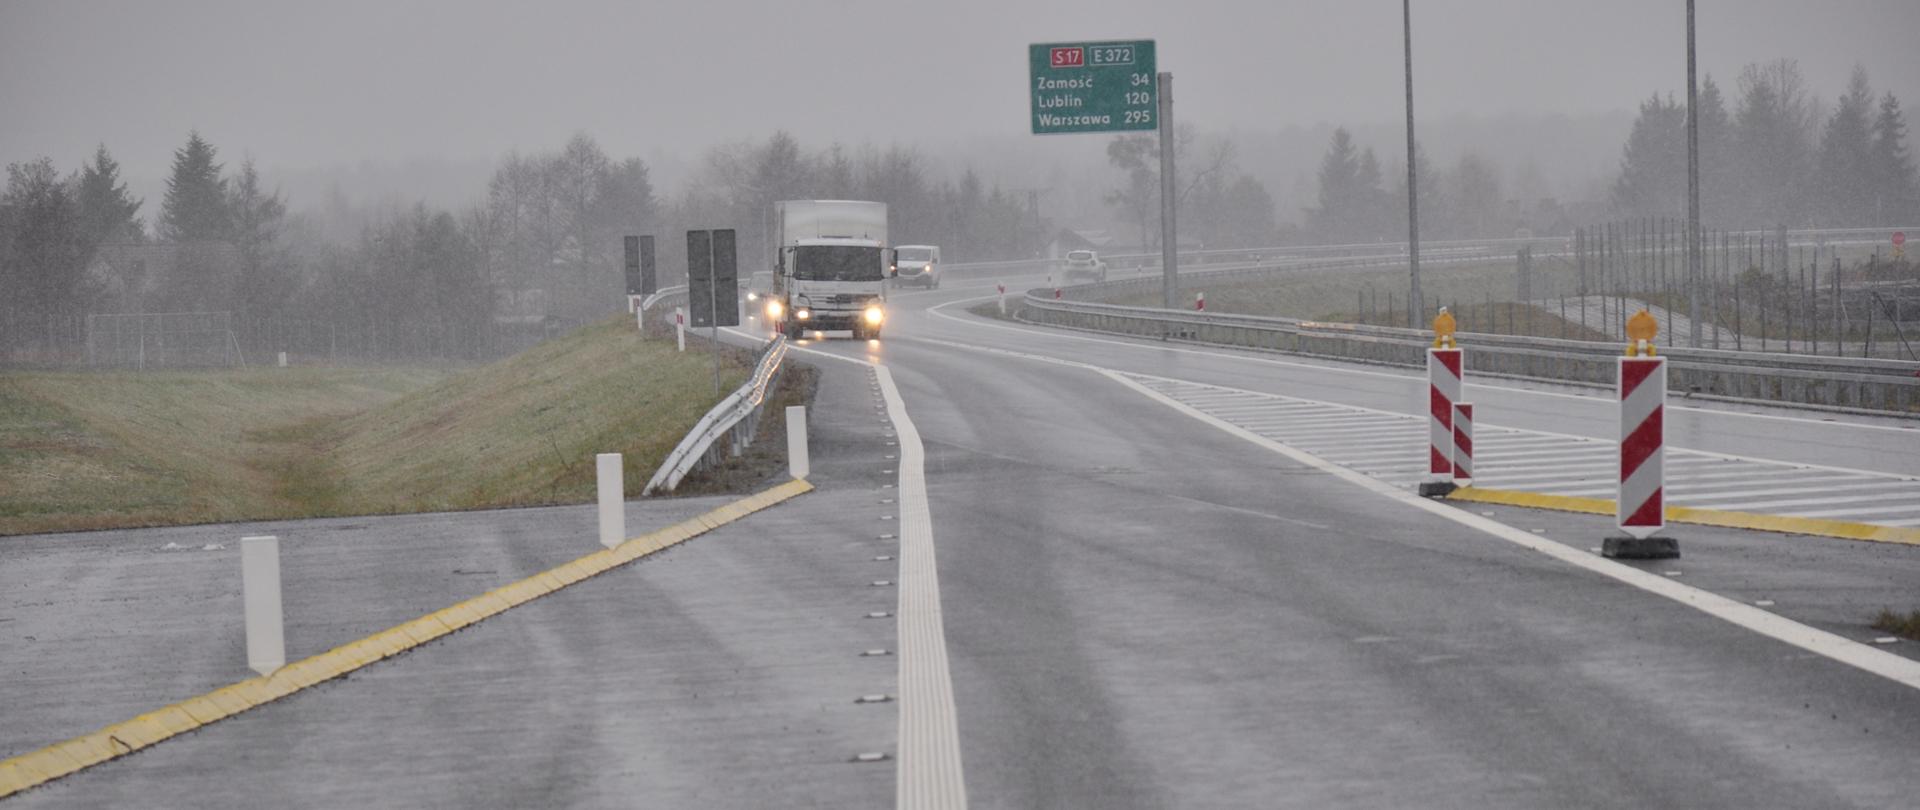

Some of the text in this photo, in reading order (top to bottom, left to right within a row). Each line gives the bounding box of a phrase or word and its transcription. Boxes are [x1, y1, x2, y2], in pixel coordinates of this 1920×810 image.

[1105, 48, 1131, 62] 372
[1037, 73, 1150, 89] Zamość 34
[1038, 92, 1150, 108] Lublin 120
[1038, 111, 1150, 127] Warszawa 295
